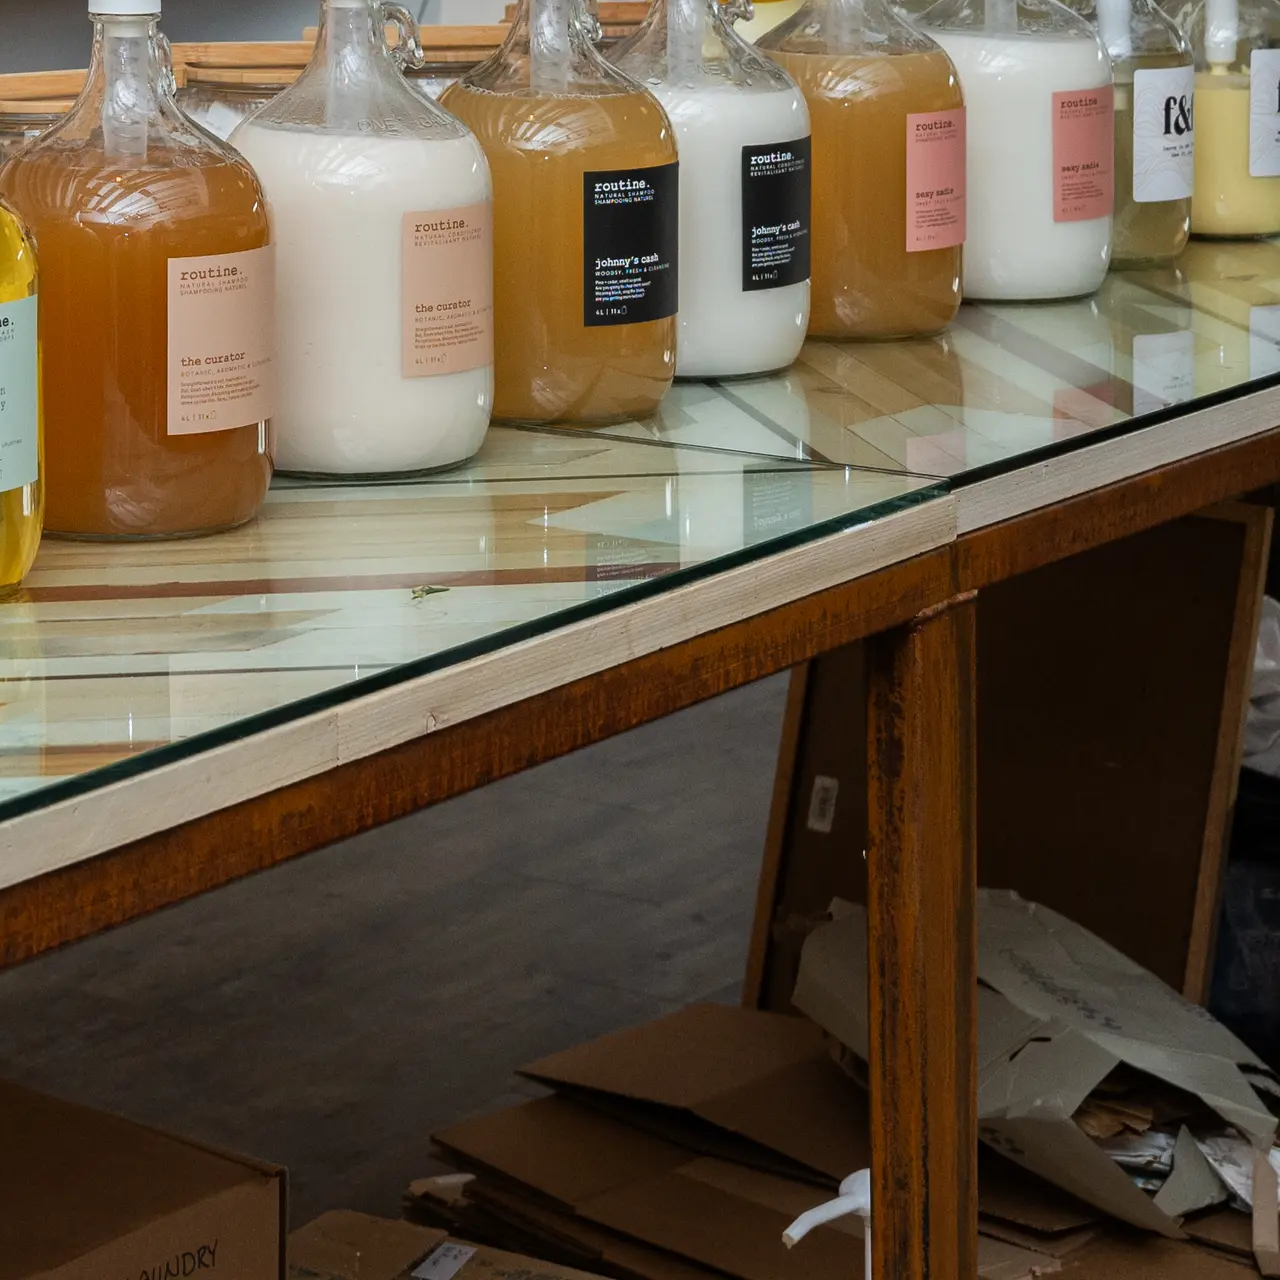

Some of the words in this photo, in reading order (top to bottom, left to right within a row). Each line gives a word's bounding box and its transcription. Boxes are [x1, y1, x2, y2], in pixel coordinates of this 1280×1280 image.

[1162, 94, 1195, 137] f&
[750, 151, 795, 165] routine.
[594, 179, 651, 193] routine.
[594, 191, 625, 199] NATURAL
[628, 189, 655, 198] SHAMPOO
[594, 196, 633, 205] SHAMPOOING
[414, 219, 469, 234] routine.
[751, 224, 787, 238] johnny's
[595, 255, 639, 270] johnny's
[640, 252, 659, 264] cash
[180, 265, 244, 282] routine.
[180, 280, 216, 290] NATURAL
[415, 302, 434, 314] the
[436, 299, 472, 312] curator
[180, 355, 202, 368] the
[204, 351, 246, 366] curator
[126, 1238, 218, 1280] AUNDRY
